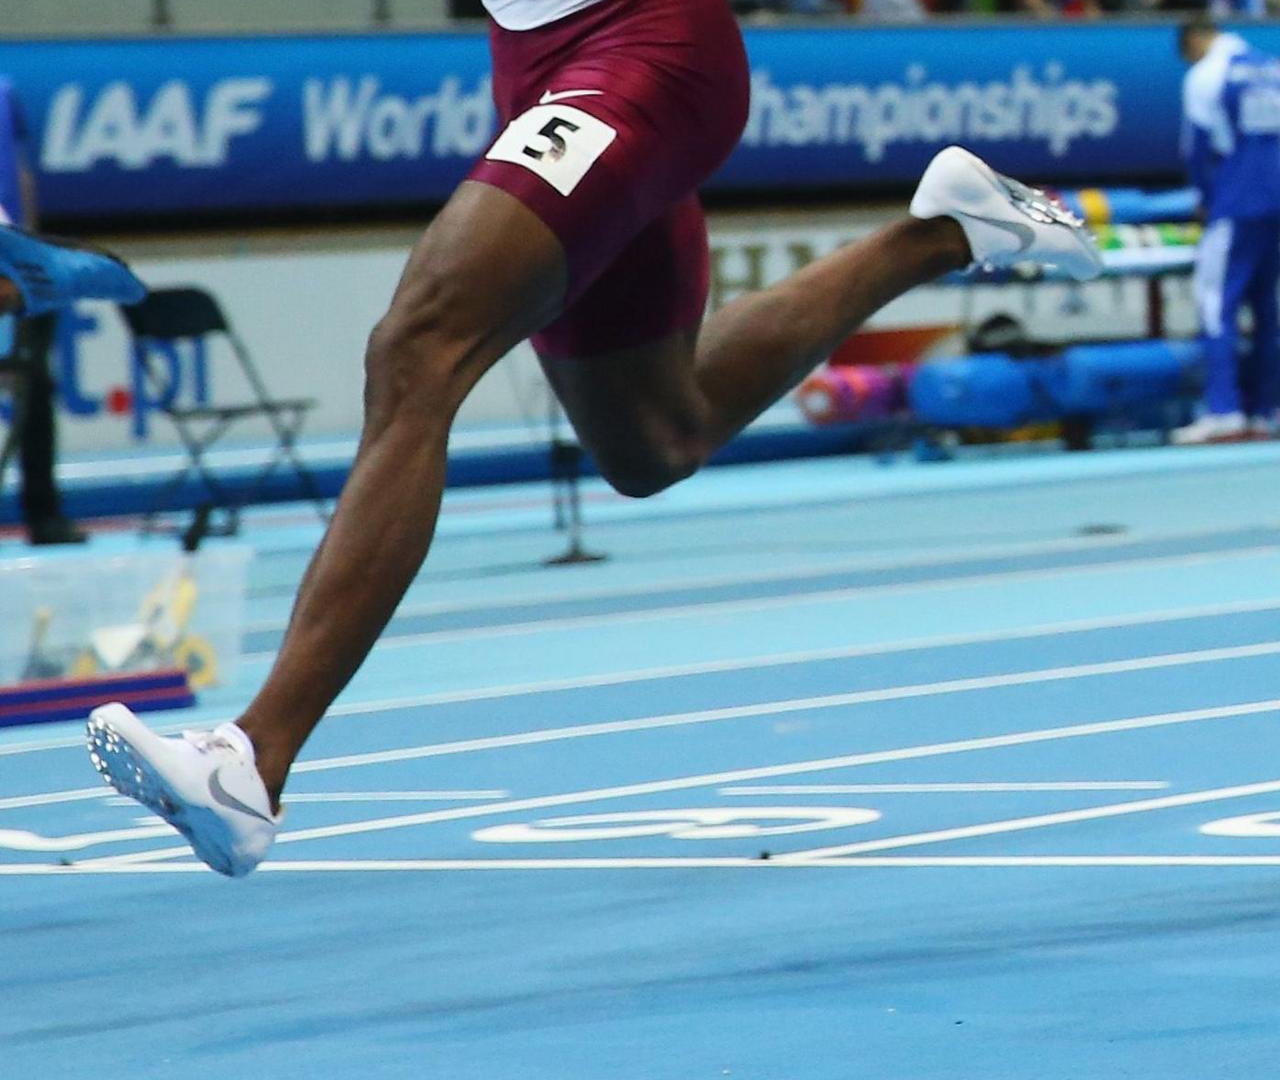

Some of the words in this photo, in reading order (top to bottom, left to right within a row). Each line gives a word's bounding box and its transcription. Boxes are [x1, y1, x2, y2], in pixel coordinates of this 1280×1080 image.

[42, 77, 271, 172] IAAF
[302, 72, 494, 162] World
[745, 62, 1118, 162] hampionships
[522, 117, 581, 163] 5
